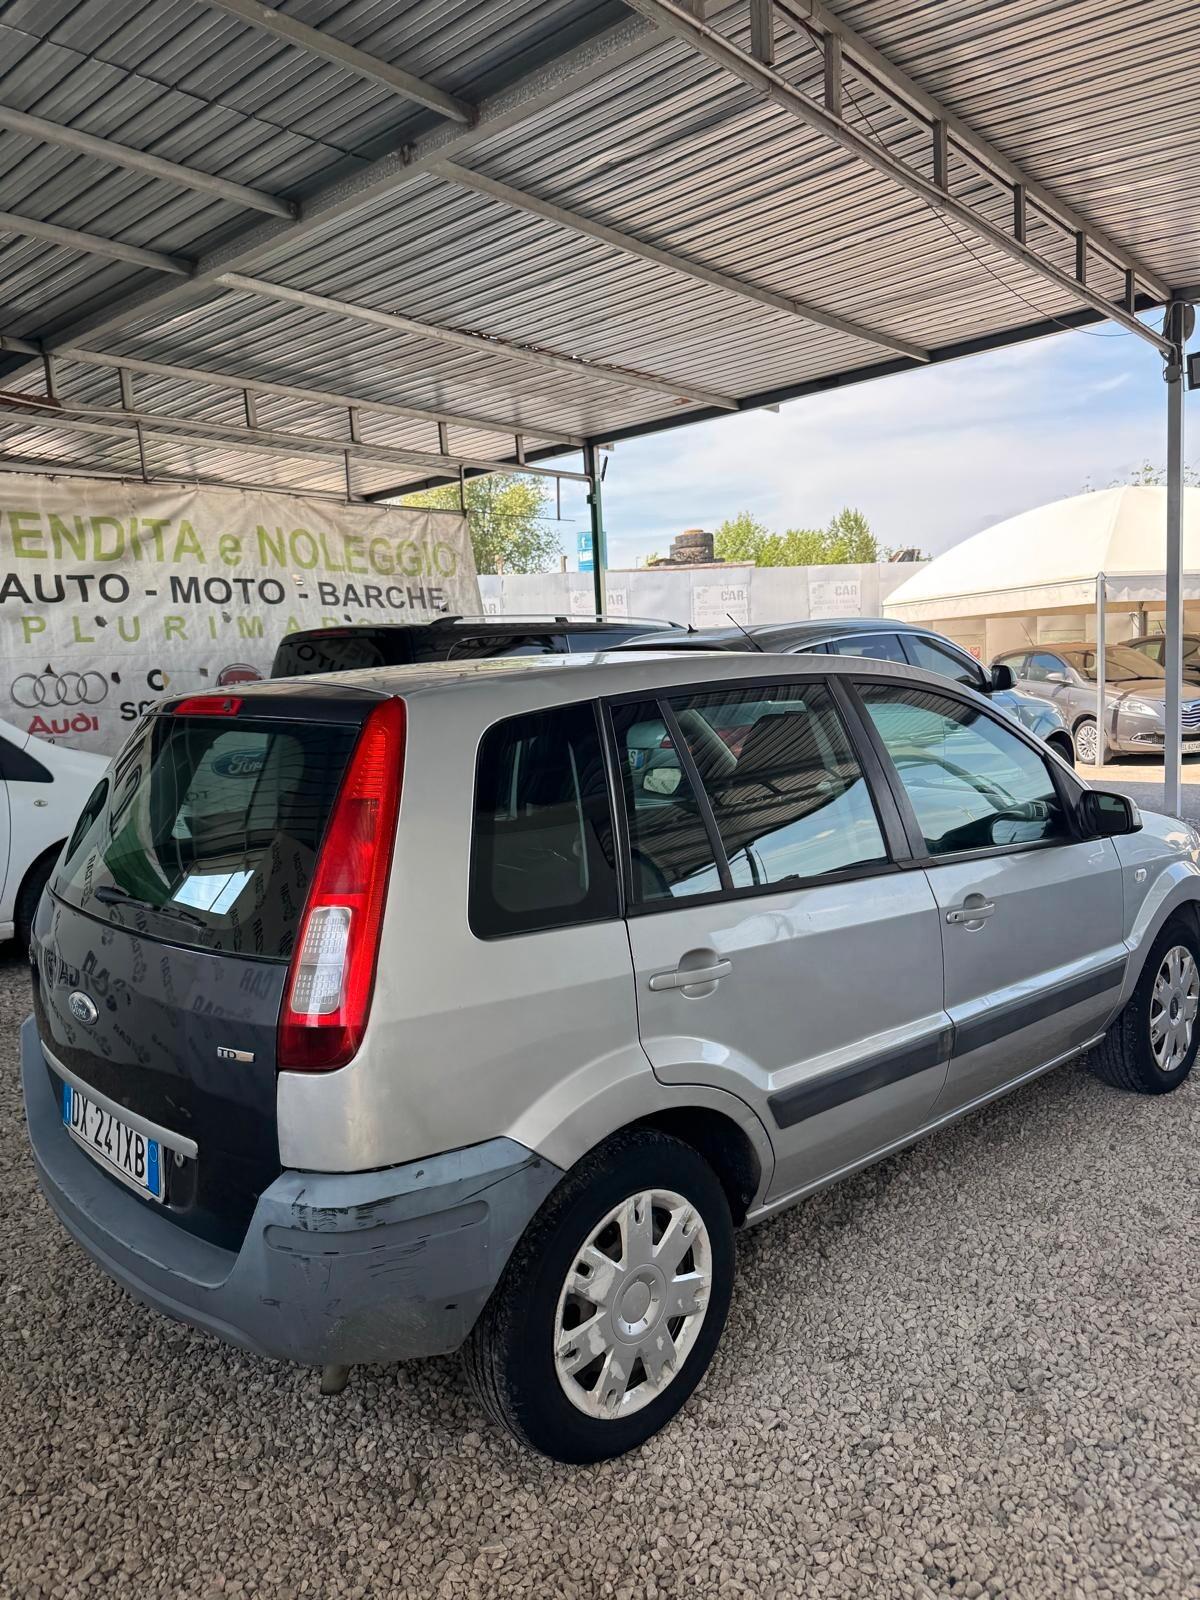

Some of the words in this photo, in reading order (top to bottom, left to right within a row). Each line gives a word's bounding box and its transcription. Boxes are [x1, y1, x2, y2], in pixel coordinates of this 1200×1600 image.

[0, 511, 207, 564] ENDITA
[218, 532, 242, 567] e
[256, 525, 457, 578] NOLEGGIO
[0, 573, 130, 604] AUTO
[169, 575, 285, 605] MOTO
[317, 581, 444, 610] BARCHE
[720, 589, 744, 602] CAR
[834, 584, 857, 596] CAR
[607, 593, 624, 605] AR
[28, 713, 99, 734] Audi
